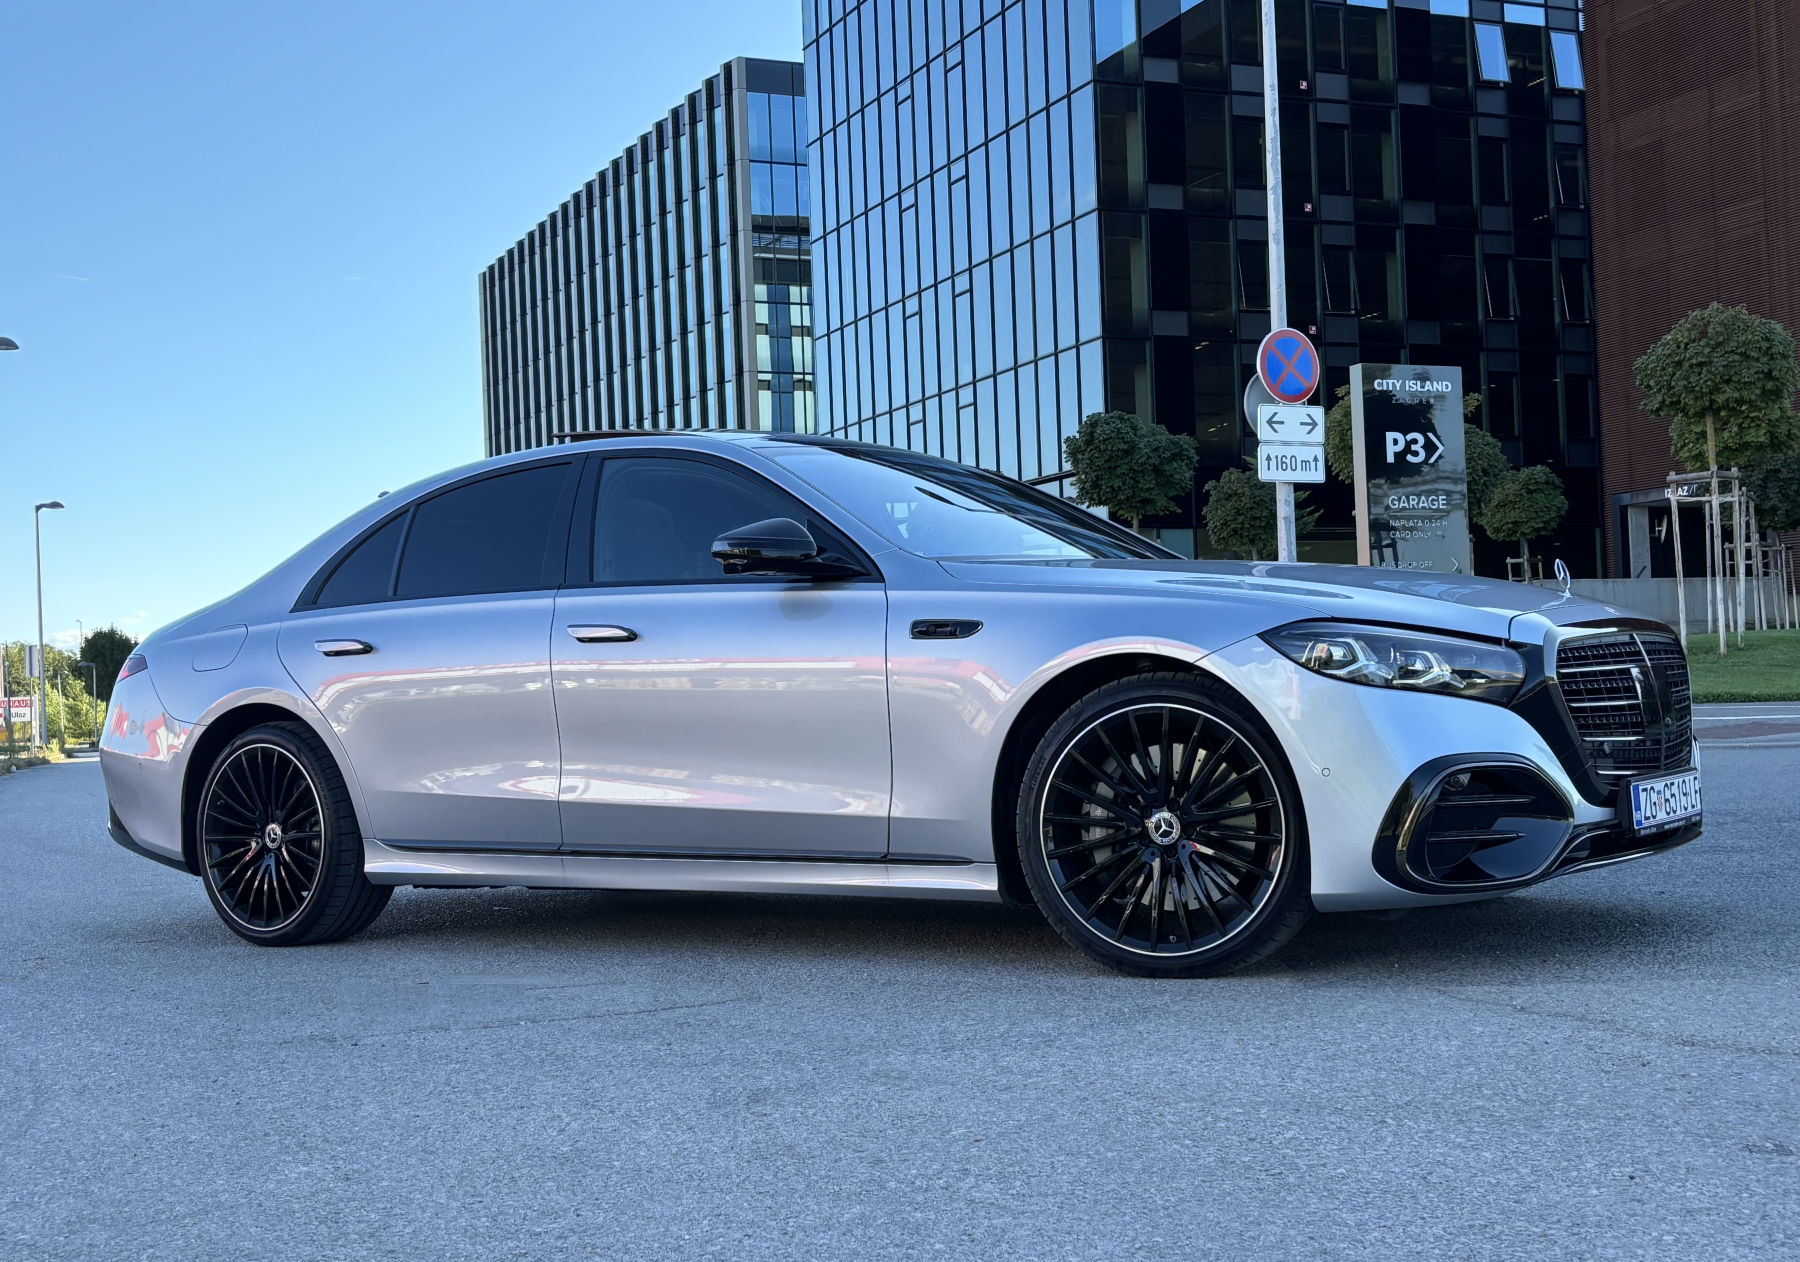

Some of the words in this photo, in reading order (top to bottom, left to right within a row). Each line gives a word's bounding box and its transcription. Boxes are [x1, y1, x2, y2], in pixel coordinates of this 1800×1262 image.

[1373, 379, 1402, 391] CITY
[1405, 380, 1452, 392] ISLAND
[1385, 431, 1426, 463] P3
[1274, 454, 1298, 472] 160
[1300, 459, 1312, 472] m
[1388, 495, 1447, 509] GARAGE
[1389, 519, 1423, 527] NAPLATA
[1442, 519, 1448, 527] H
[1389, 530, 1411, 538] CARD
[1419, 561, 1433, 569] OFF
[11, 711, 26, 719] Ulaz
[1641, 785, 1658, 821] ZG
